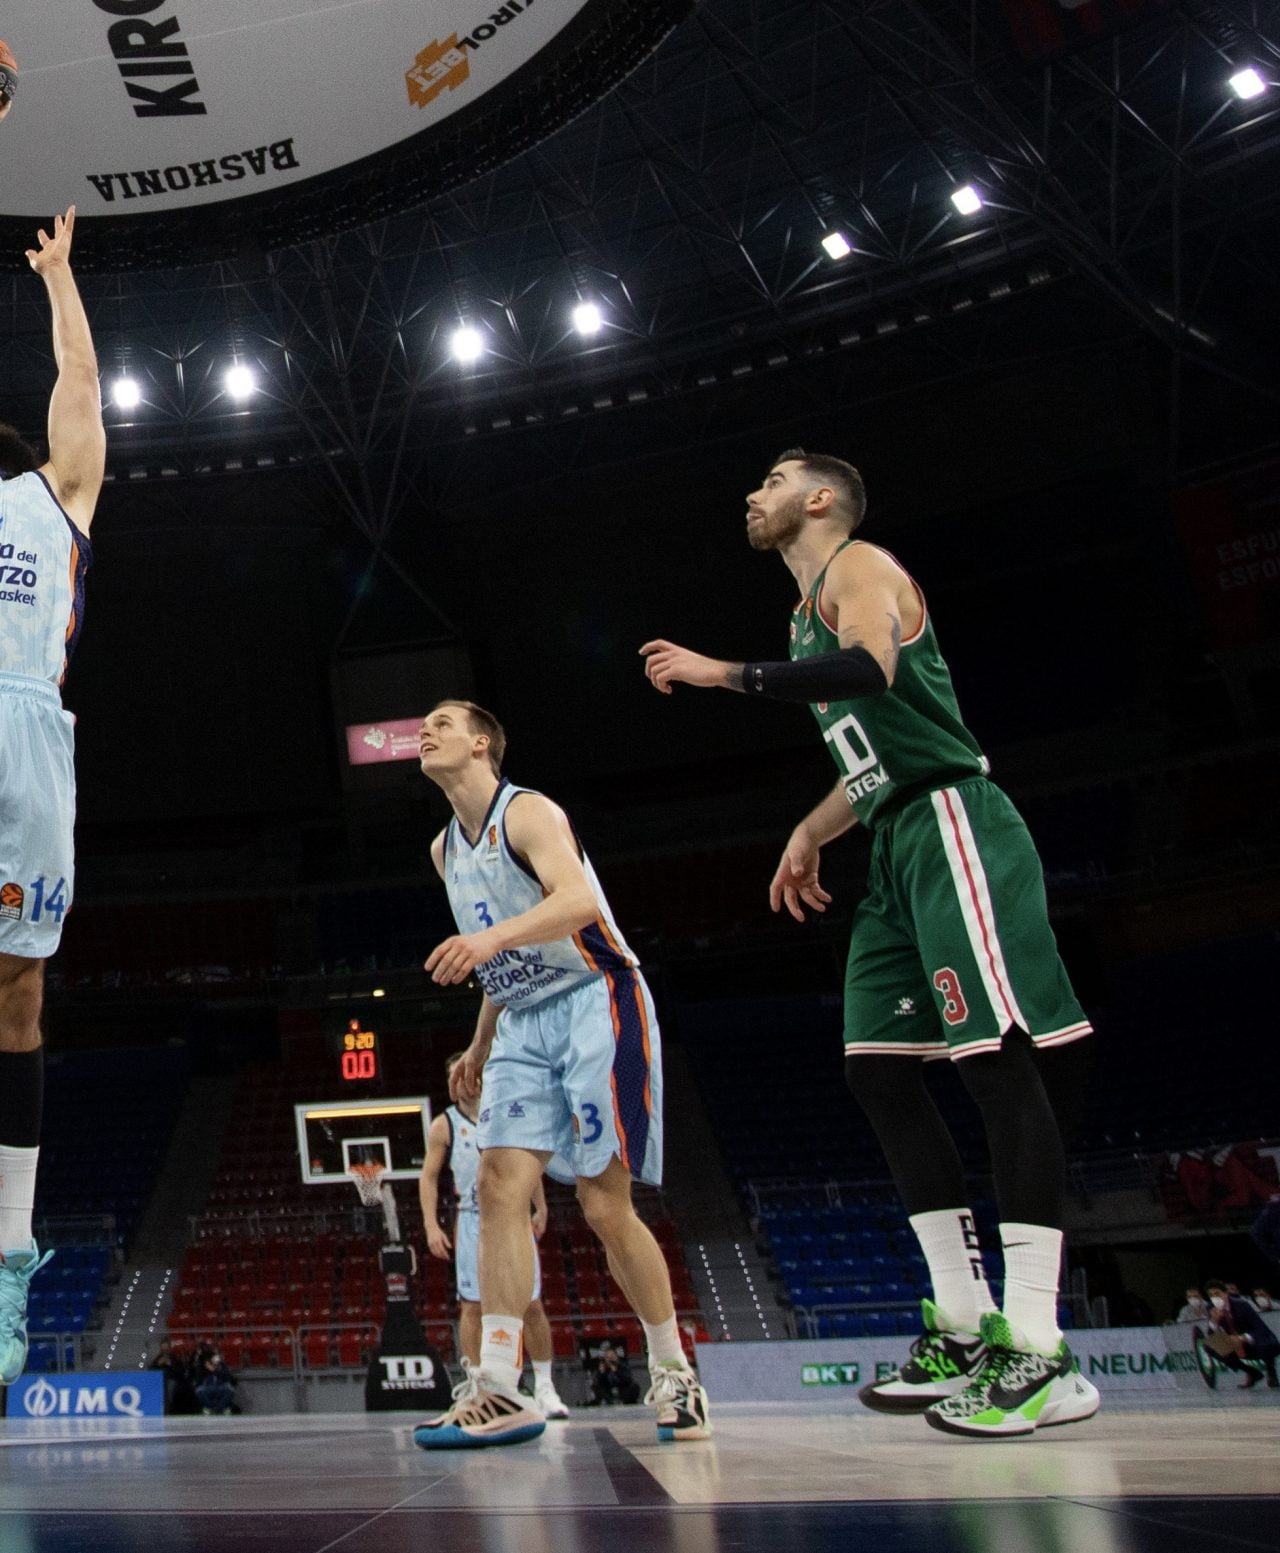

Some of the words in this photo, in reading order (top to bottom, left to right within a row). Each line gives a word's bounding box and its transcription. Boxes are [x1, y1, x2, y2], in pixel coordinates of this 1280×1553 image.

[86, 138, 300, 202] BASKONIA
[17, 550, 38, 565] del
[30, 876, 65, 923] 14
[475, 902, 494, 928] 3
[933, 965, 969, 1027] 3
[581, 1103, 603, 1144] 3
[378, 1354, 435, 1381] TD
[802, 1366, 858, 1382] BKT
[381, 1380, 436, 1390] SYSTEMS
[58, 1386, 145, 1418] IMQ
